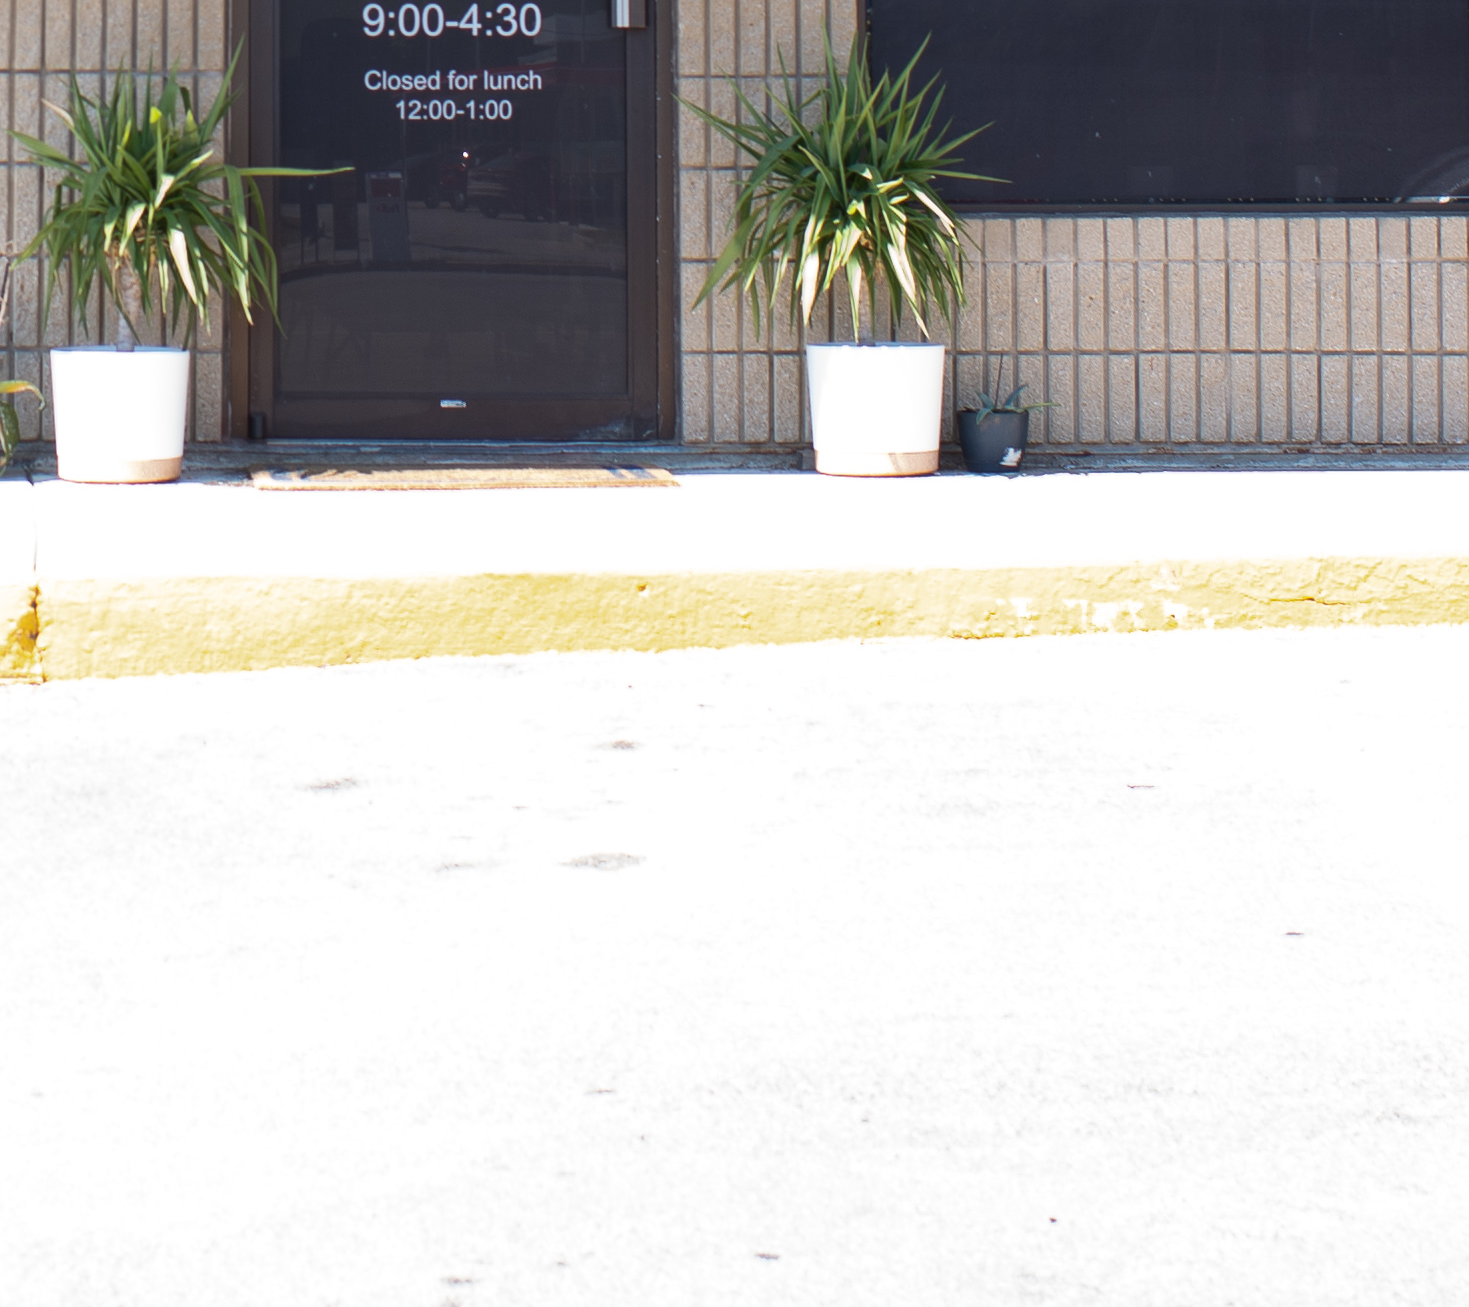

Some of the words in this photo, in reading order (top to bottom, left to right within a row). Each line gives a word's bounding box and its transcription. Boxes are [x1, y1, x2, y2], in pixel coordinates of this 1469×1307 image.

[362, 2, 542, 37] 9:00-4:30
[364, 69, 441, 91] Closed
[447, 69, 478, 91] for
[483, 69, 543, 91] lunch
[395, 99, 513, 120] 12:00-1:00
